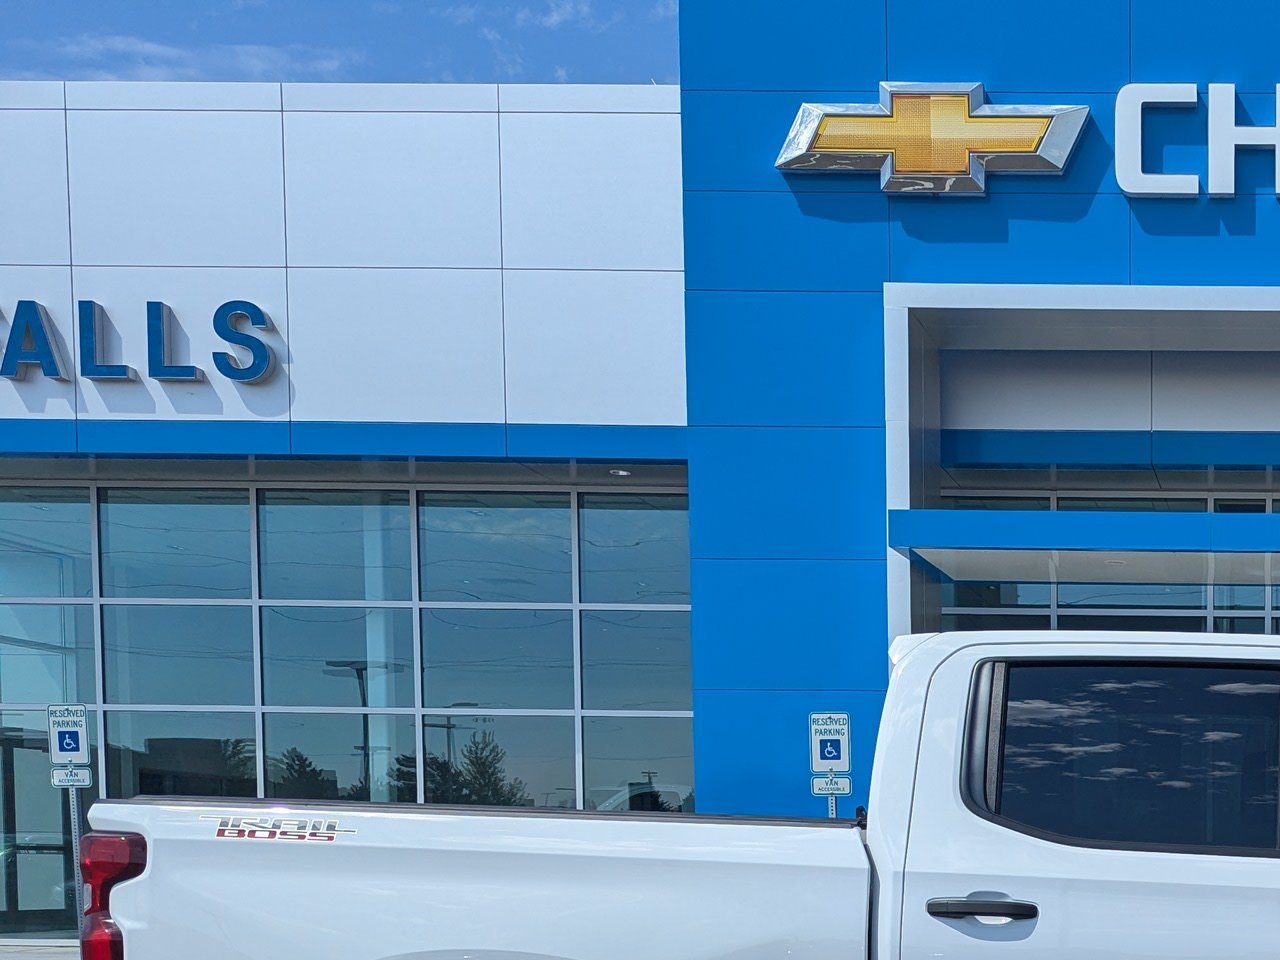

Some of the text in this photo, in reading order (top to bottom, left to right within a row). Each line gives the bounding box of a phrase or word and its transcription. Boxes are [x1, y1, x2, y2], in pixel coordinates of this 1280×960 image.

[0, 300, 275, 383] ALLS
[49, 709, 85, 718] RESERVED
[52, 720, 83, 728] PARKING
[812, 718, 847, 726] RESERVED
[814, 728, 846, 736] PARKING
[200, 815, 357, 833] TRAIL
[216, 828, 336, 842] BOSS
